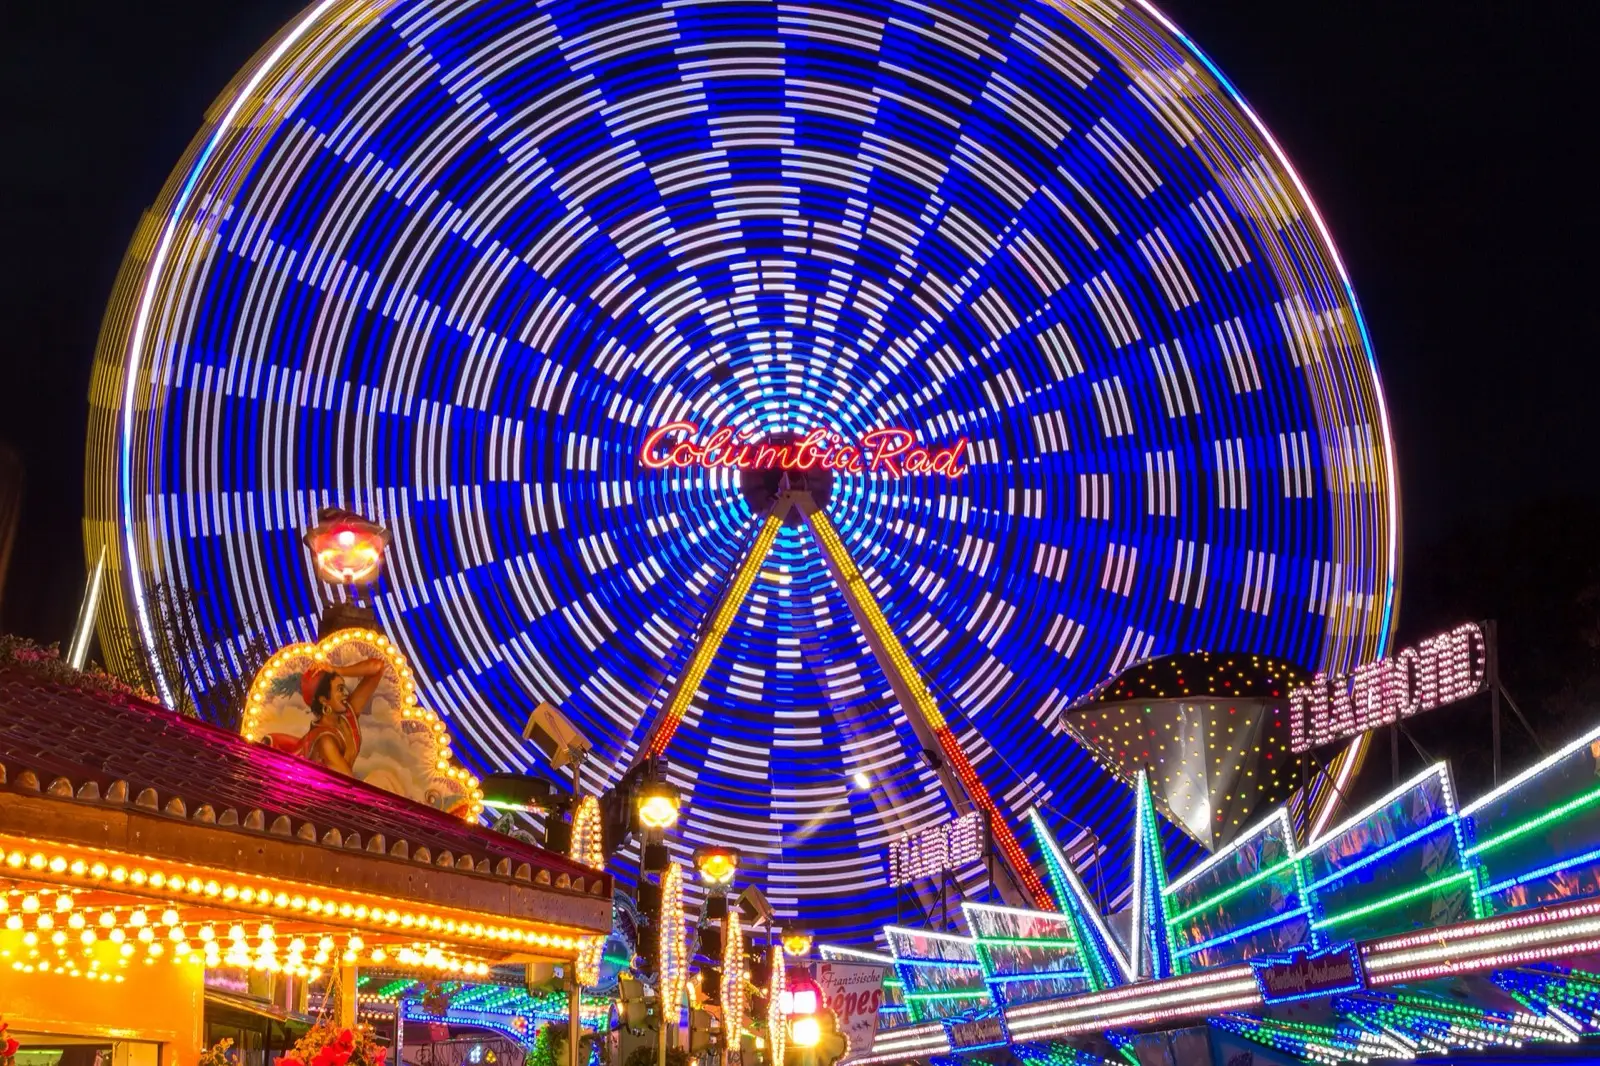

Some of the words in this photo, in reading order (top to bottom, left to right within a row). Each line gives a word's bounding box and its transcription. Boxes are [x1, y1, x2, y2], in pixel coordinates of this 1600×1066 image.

[639, 420, 862, 473] Columbia
[864, 428, 970, 479] Rad
[821, 968, 880, 988] Französische
[827, 986, 882, 1025] êpes
